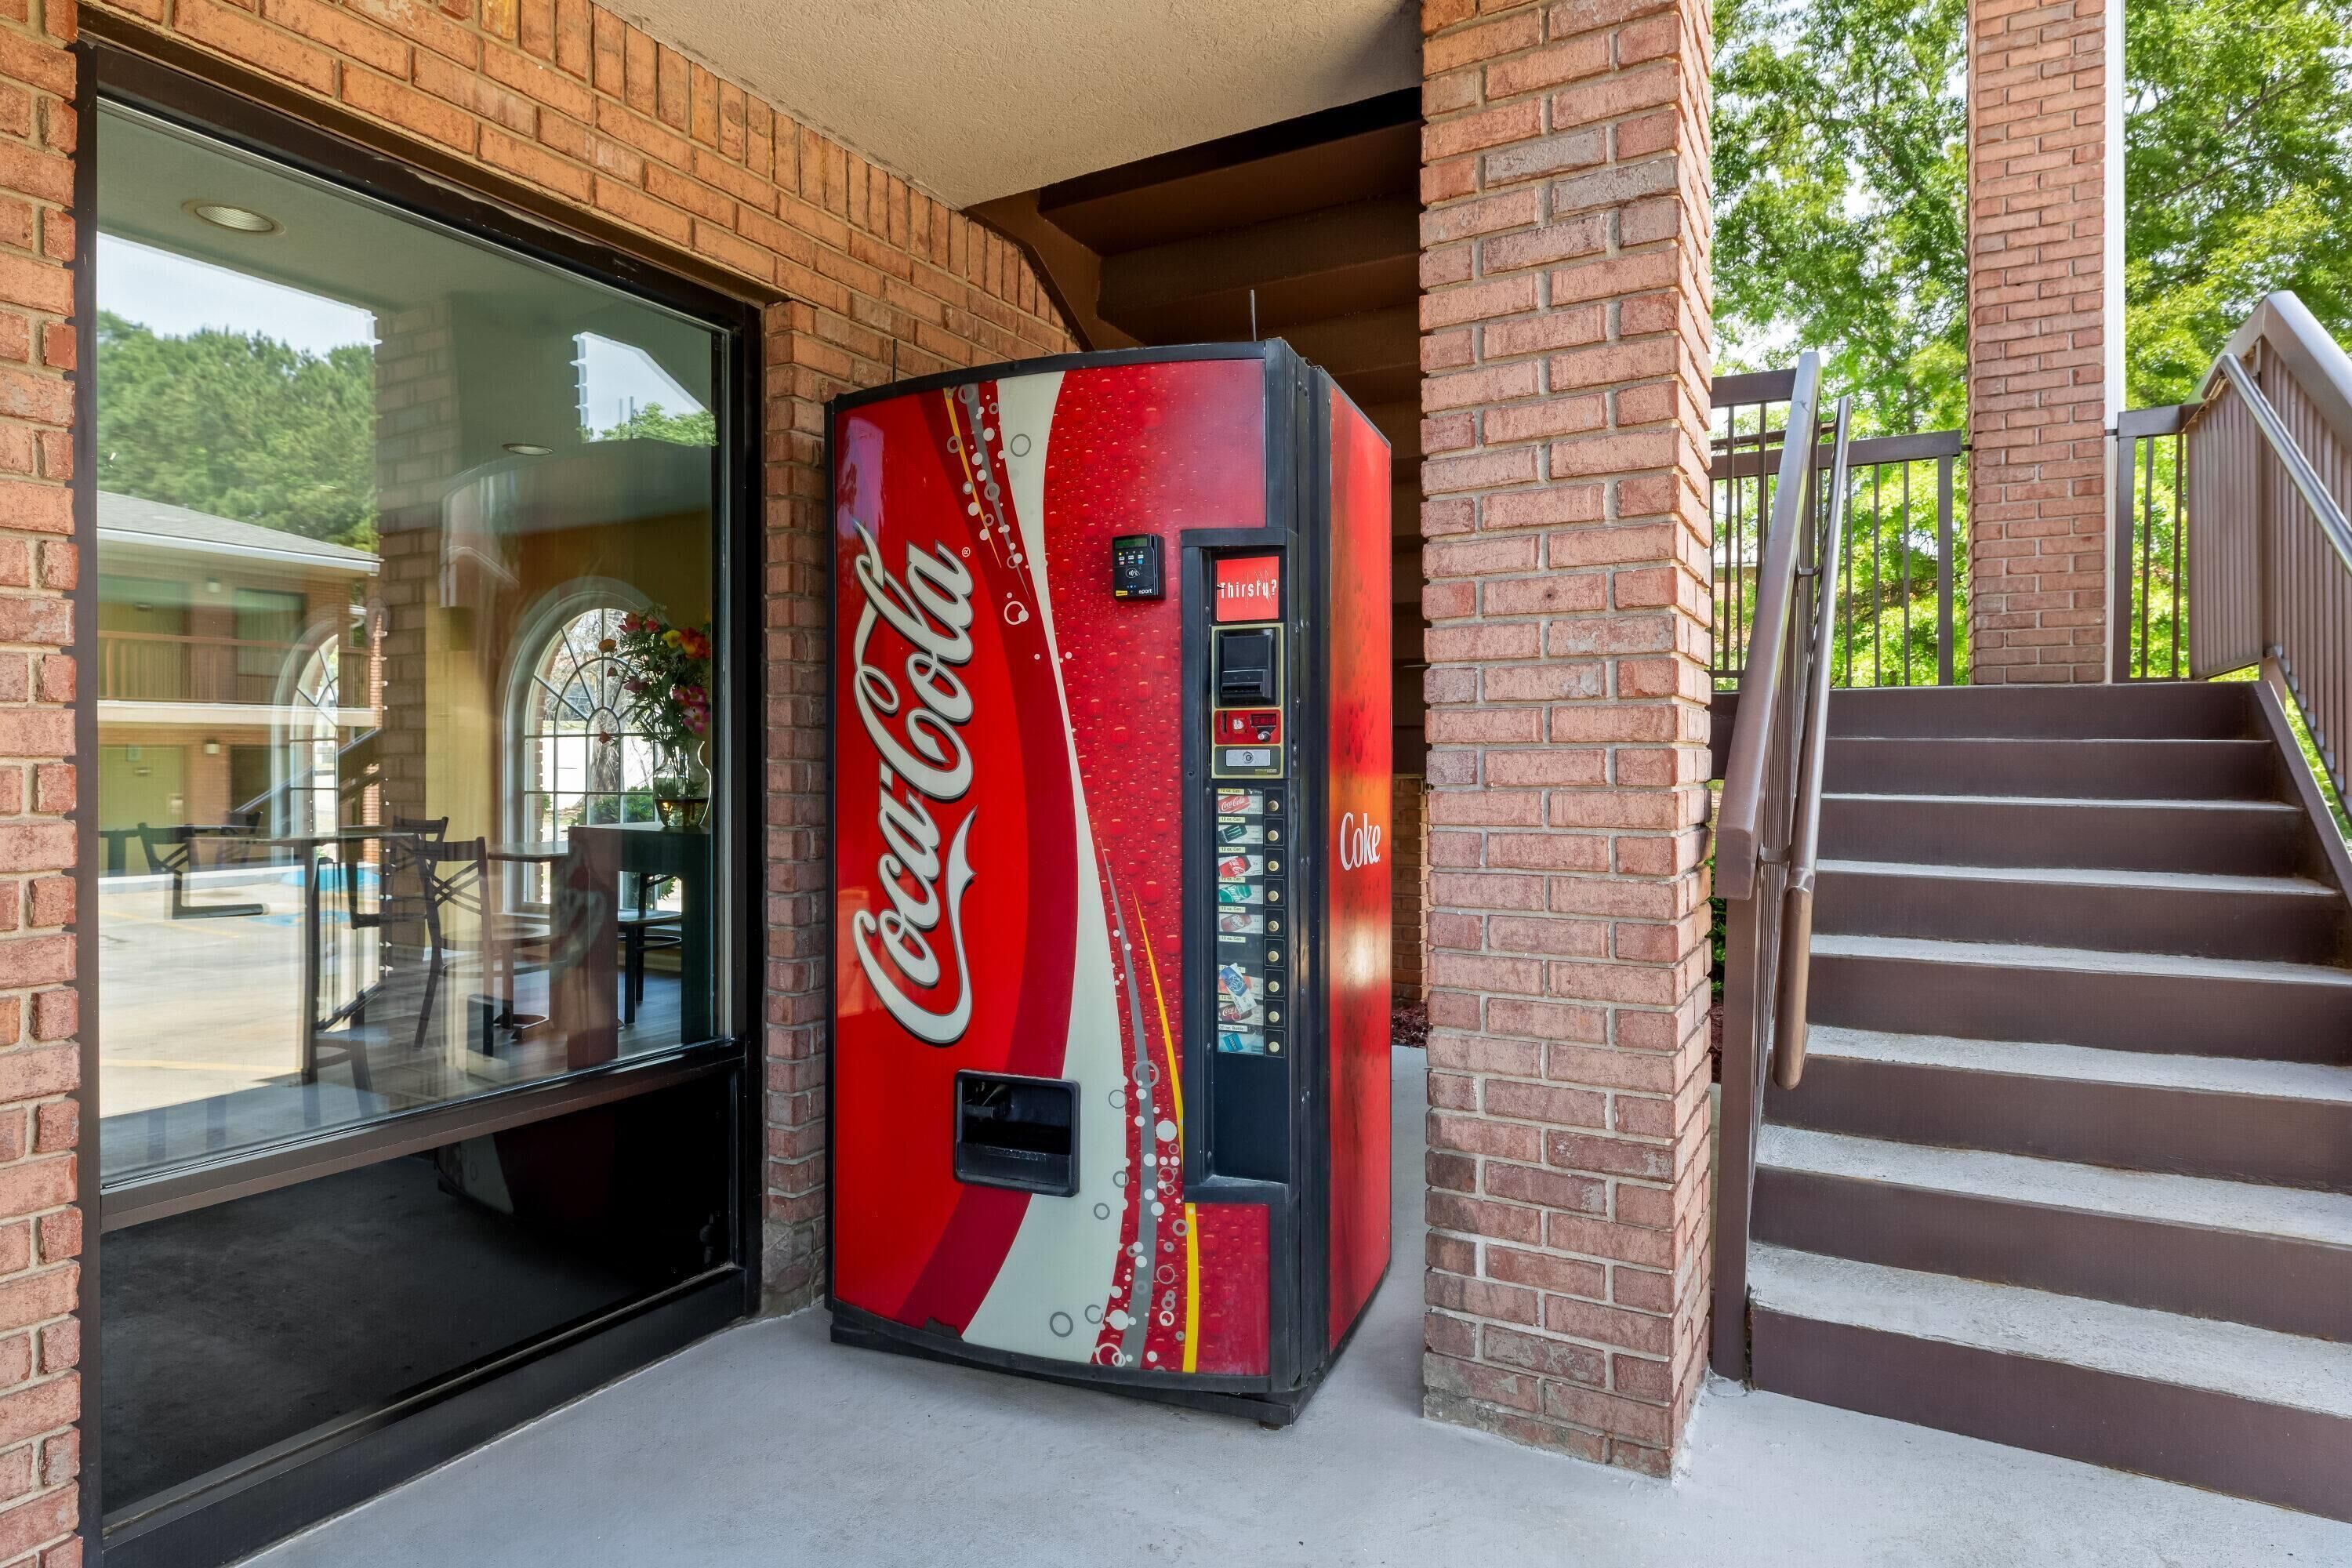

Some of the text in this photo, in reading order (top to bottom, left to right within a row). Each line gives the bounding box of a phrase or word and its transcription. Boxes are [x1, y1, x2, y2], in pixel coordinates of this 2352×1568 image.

[1220, 579, 1277, 599] Thirsty?
[851, 518, 977, 1044] Coca-Cola
[1340, 811, 1381, 871] Coke
